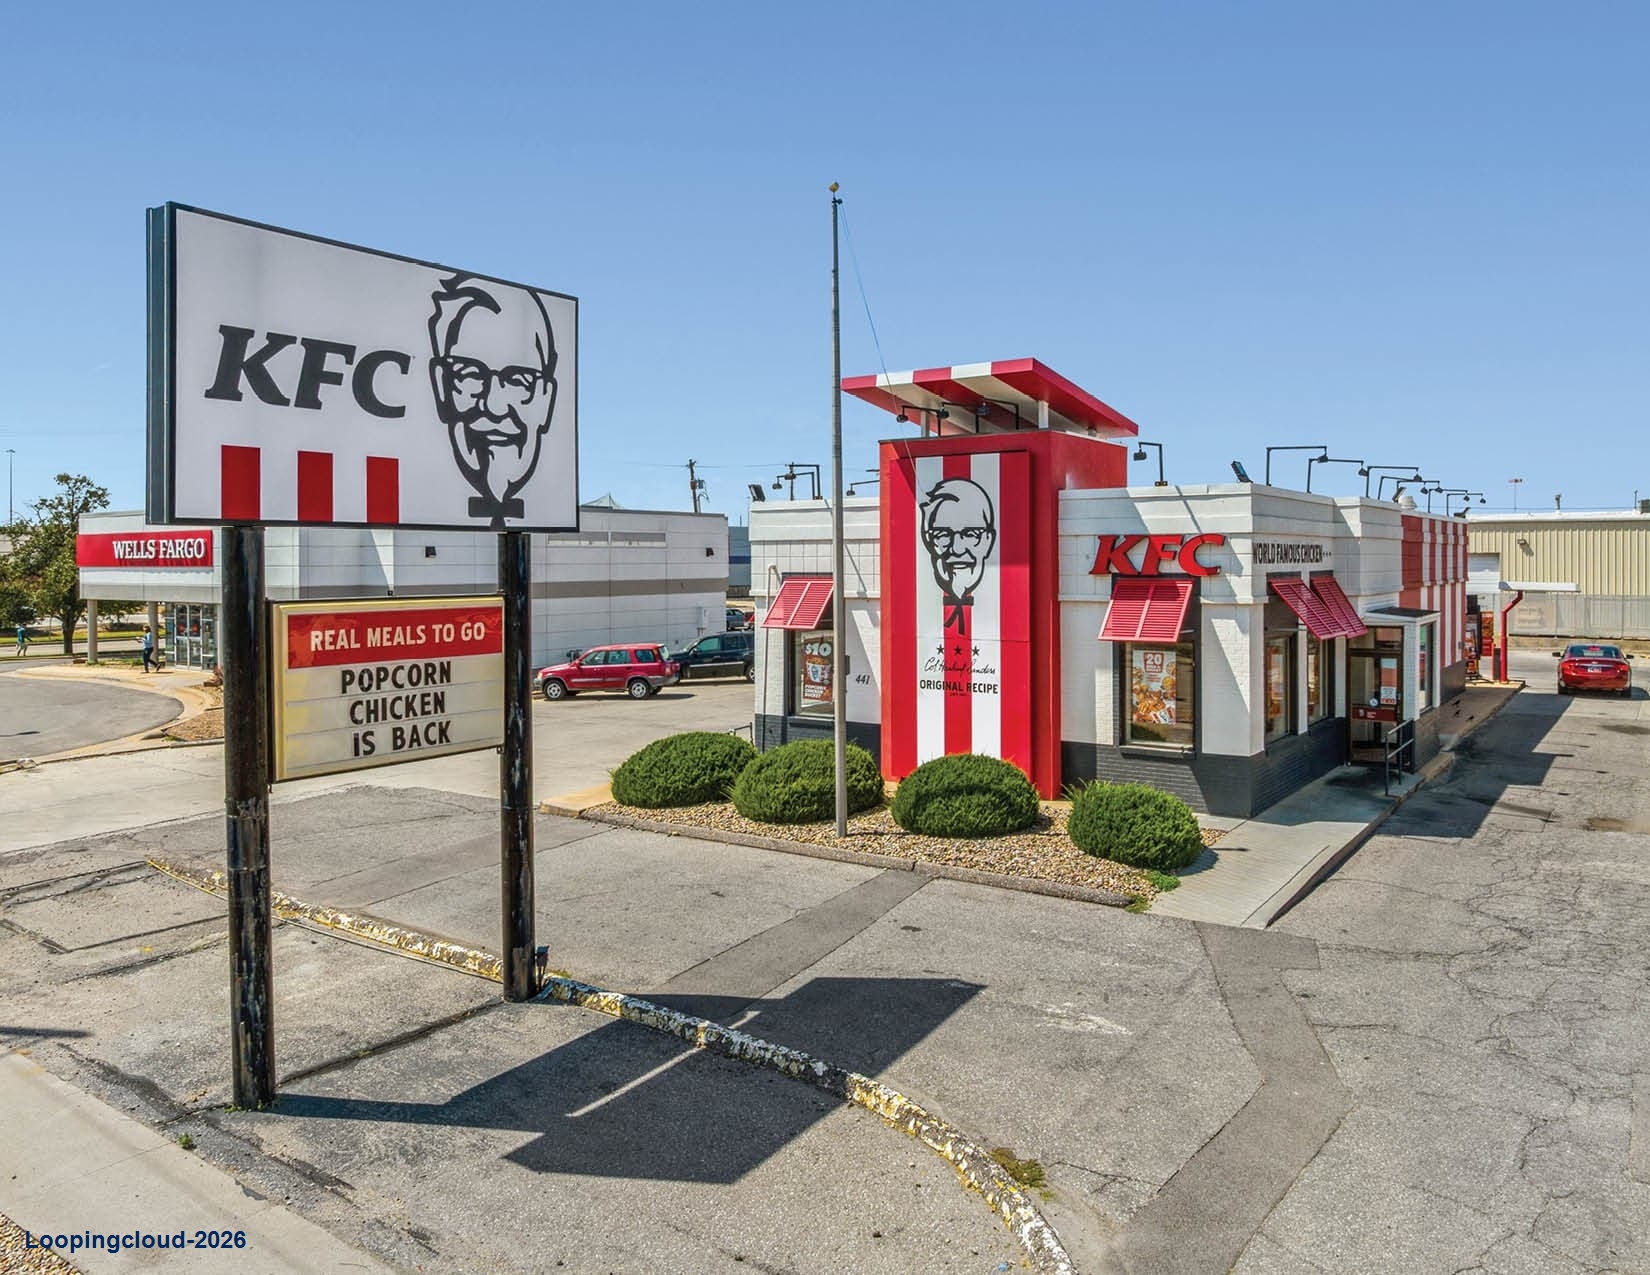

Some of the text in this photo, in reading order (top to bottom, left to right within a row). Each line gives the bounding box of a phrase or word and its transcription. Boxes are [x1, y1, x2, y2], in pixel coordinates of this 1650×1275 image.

[204, 324, 411, 418] KFC
[112, 538, 205, 560] WELLS FARGO
[1088, 533, 1226, 577] KFC
[1252, 543, 1323, 564] WORLD FAMOUS CHICKEN
[310, 622, 485, 652] REAL MEALS TO GO
[1146, 653, 1162, 665] 20
[341, 661, 451, 694] POPCORN
[855, 674, 870, 685] 441
[919, 680, 964, 692] ORIGINAL
[966, 682, 999, 694] RECIPE
[350, 691, 446, 725] CHICKEN
[353, 720, 451, 757] IS BACK
